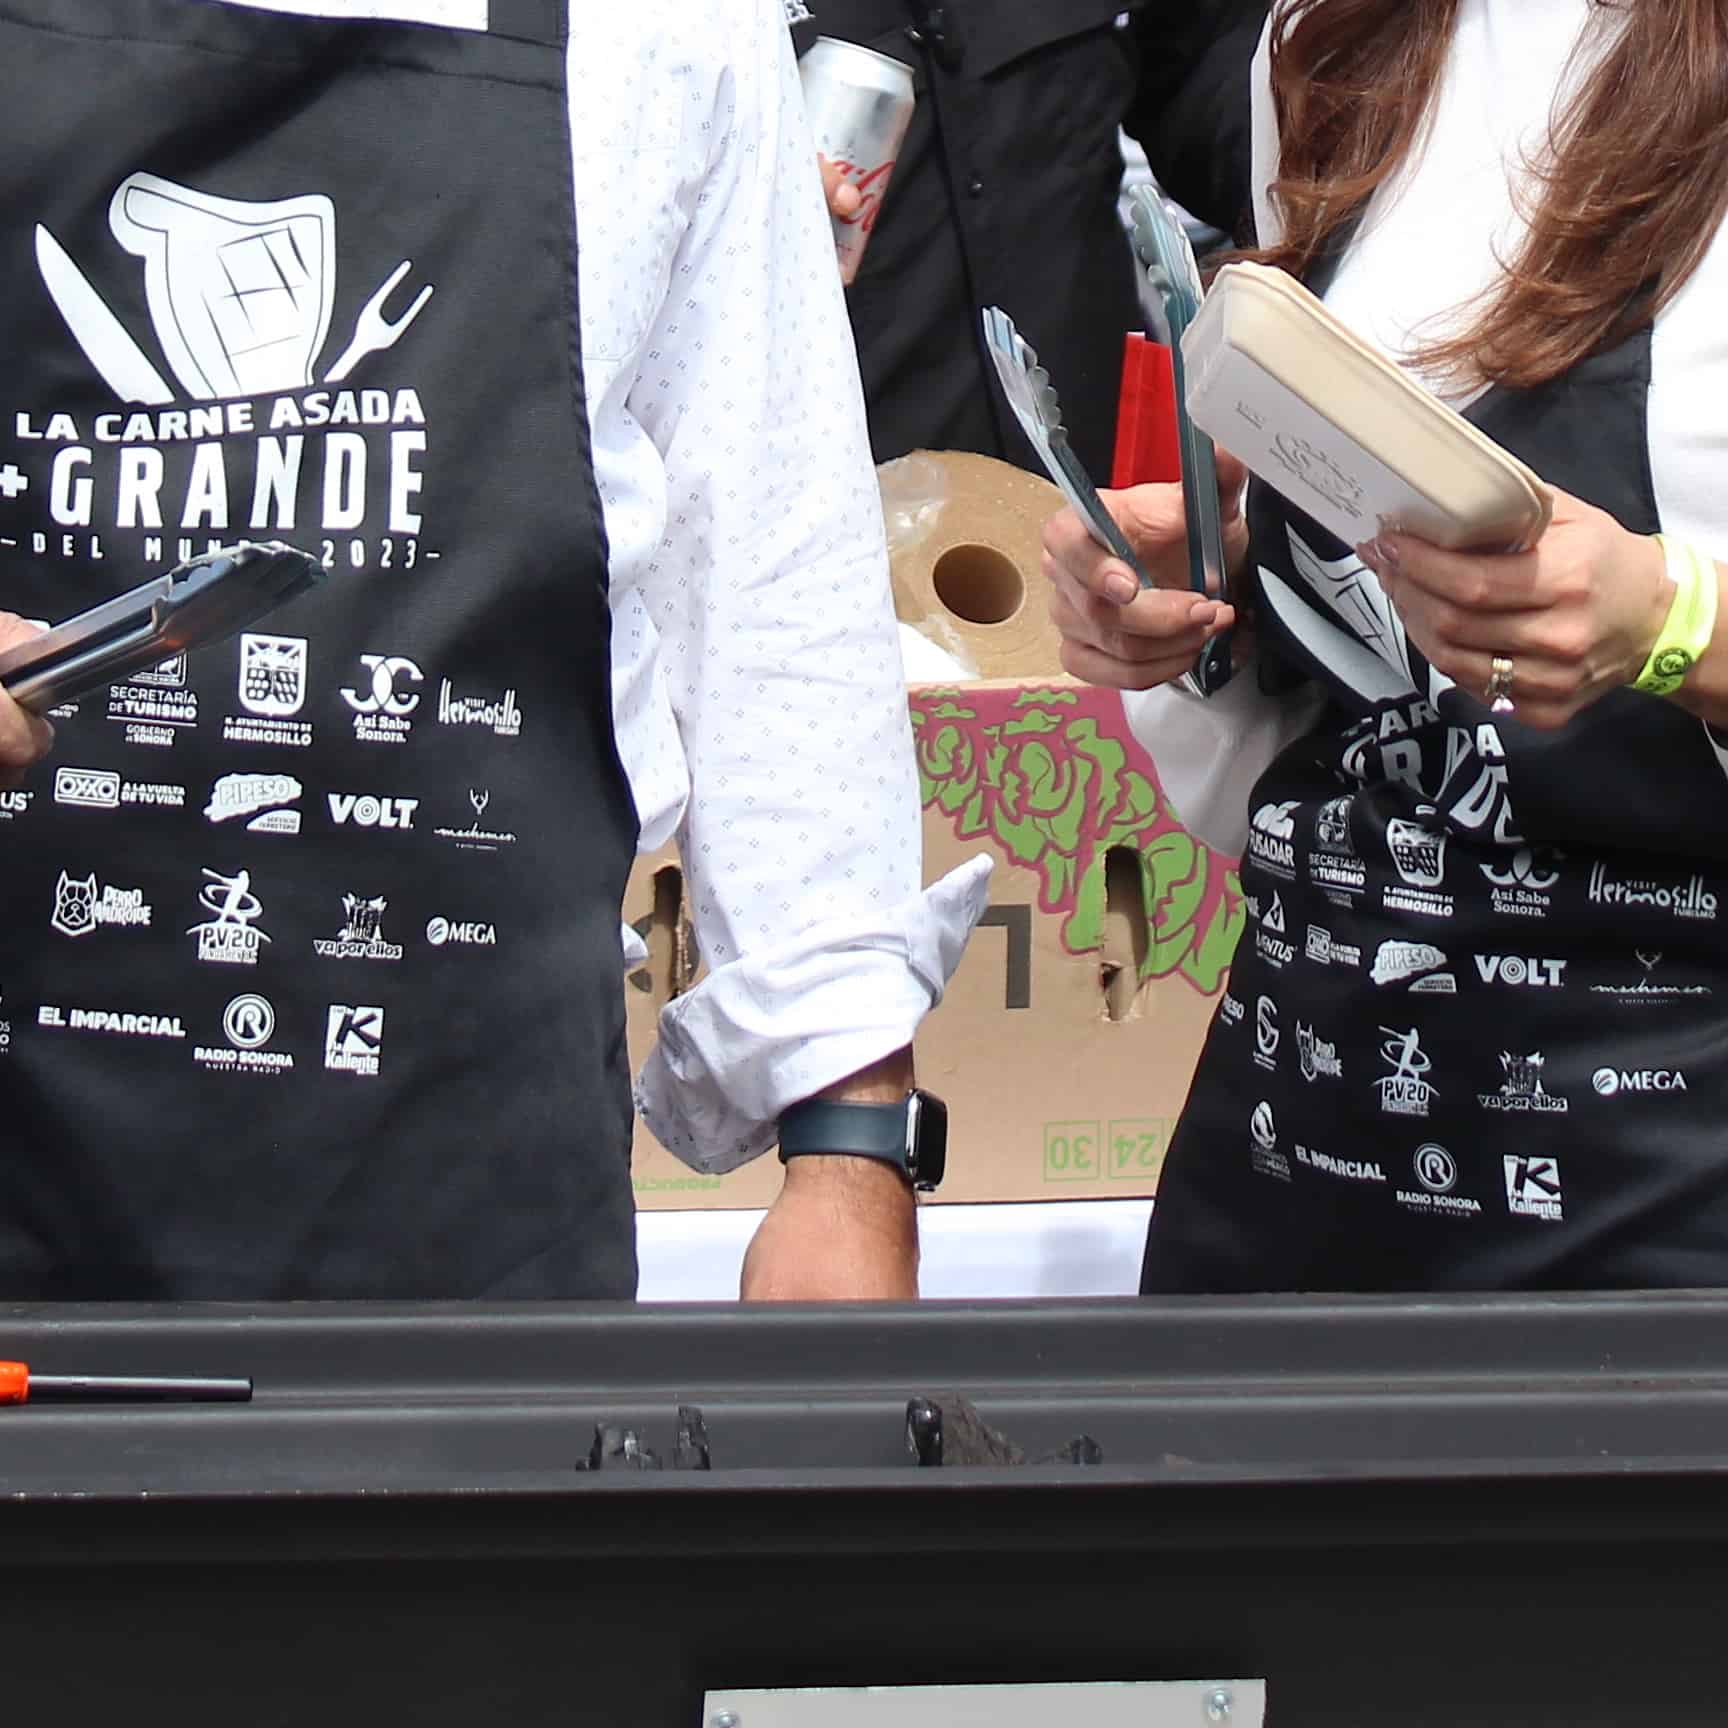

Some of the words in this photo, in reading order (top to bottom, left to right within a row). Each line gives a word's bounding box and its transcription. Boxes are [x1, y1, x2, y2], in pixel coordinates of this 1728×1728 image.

[15, 411, 81, 441] LA
[94, 401, 256, 443] CARNE
[269, 387, 426, 429] ASADA
[144, 536, 272, 560] MUN
[123, 700, 198, 721] TURISMO
[438, 676, 522, 726] Hermosillo
[223, 726, 313, 747] HERMOSILLO
[58, 775, 114, 798] OXXO
[1318, 869, 1366, 887] TURISMO
[1588, 859, 1718, 910] Hermosillo
[1382, 894, 1455, 918] HERMOSILLO
[1515, 890, 1551, 906] Sabe
[449, 922, 497, 946] MEGA
[336, 941, 366, 958] por
[366, 940, 403, 959] ellos
[1378, 946, 1436, 971] PIPESO
[38, 1005, 67, 1027] EL
[69, 1008, 188, 1038] IMPARCIAL
[193, 1046, 238, 1064] RADIO
[238, 1049, 294, 1068] SONORA
[1383, 1079, 1428, 1102] PV20
[1620, 1070, 1688, 1091] MEGA
[1310, 1149, 1387, 1181] IMPARCIAL
[1395, 1189, 1431, 1205] RADIO
[1432, 1191, 1482, 1211] SONORA
